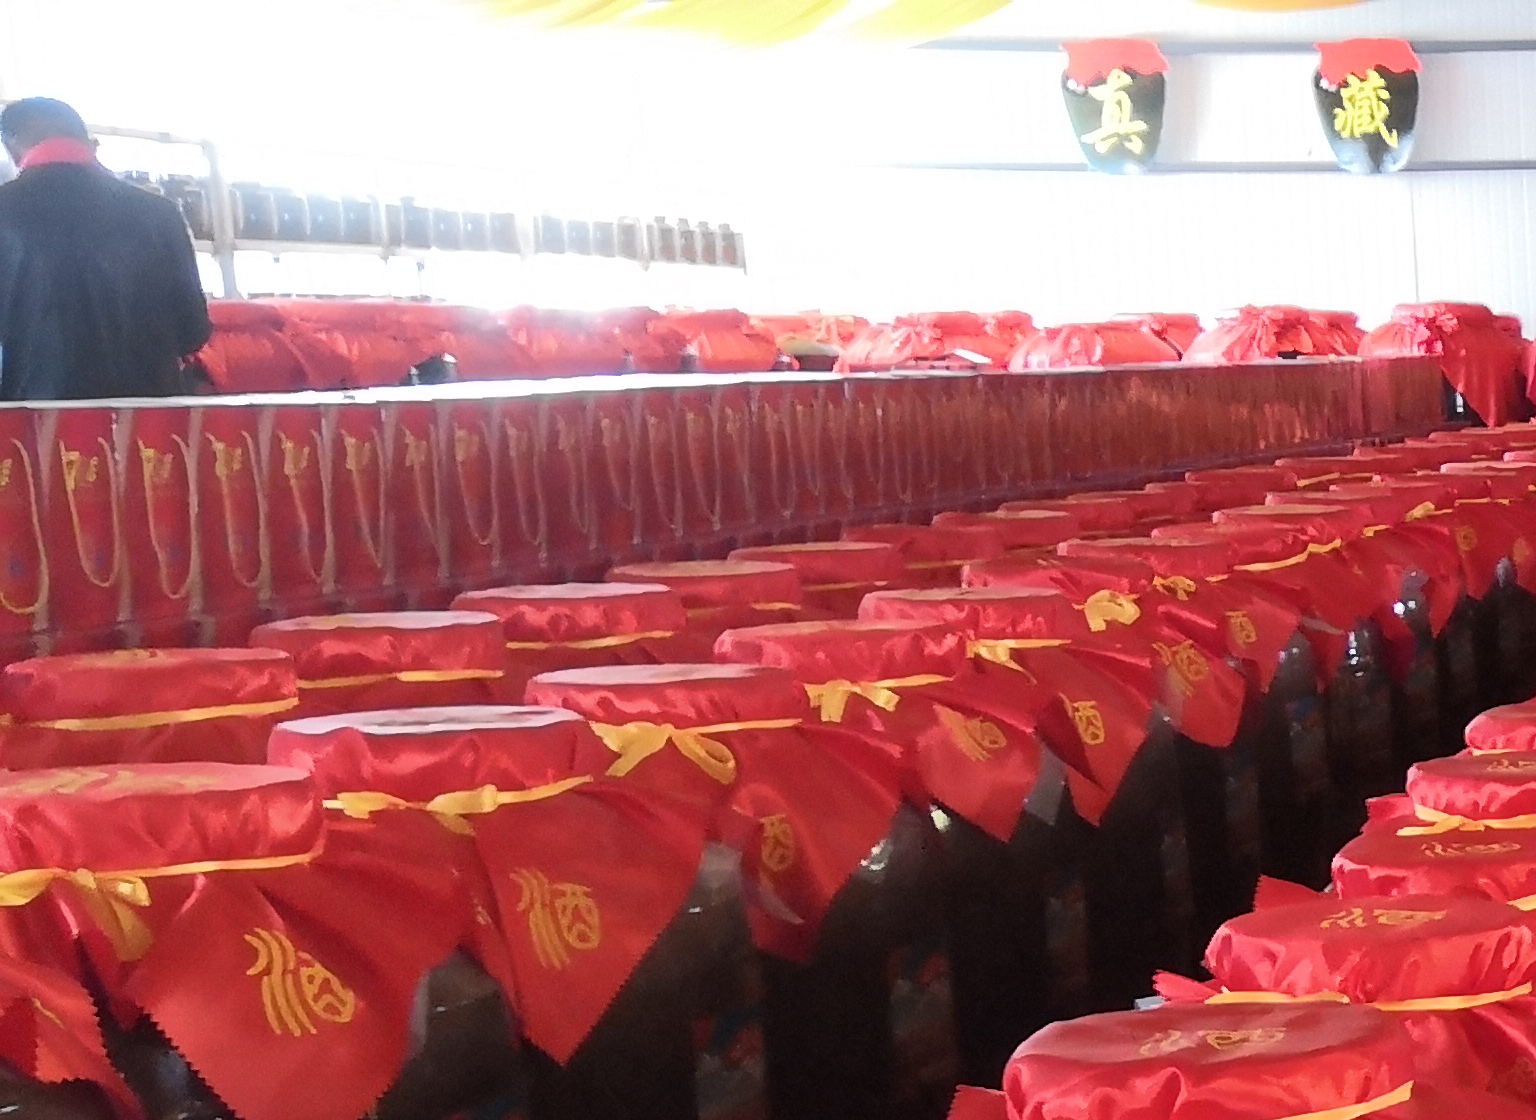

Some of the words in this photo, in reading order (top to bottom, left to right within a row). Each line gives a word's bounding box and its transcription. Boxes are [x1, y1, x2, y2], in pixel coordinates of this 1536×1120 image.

[1081, 68, 1149, 155] 真
[1335, 71, 1397, 144] 藏
[509, 868, 601, 970] 酒
[245, 929, 355, 1036] 酒
